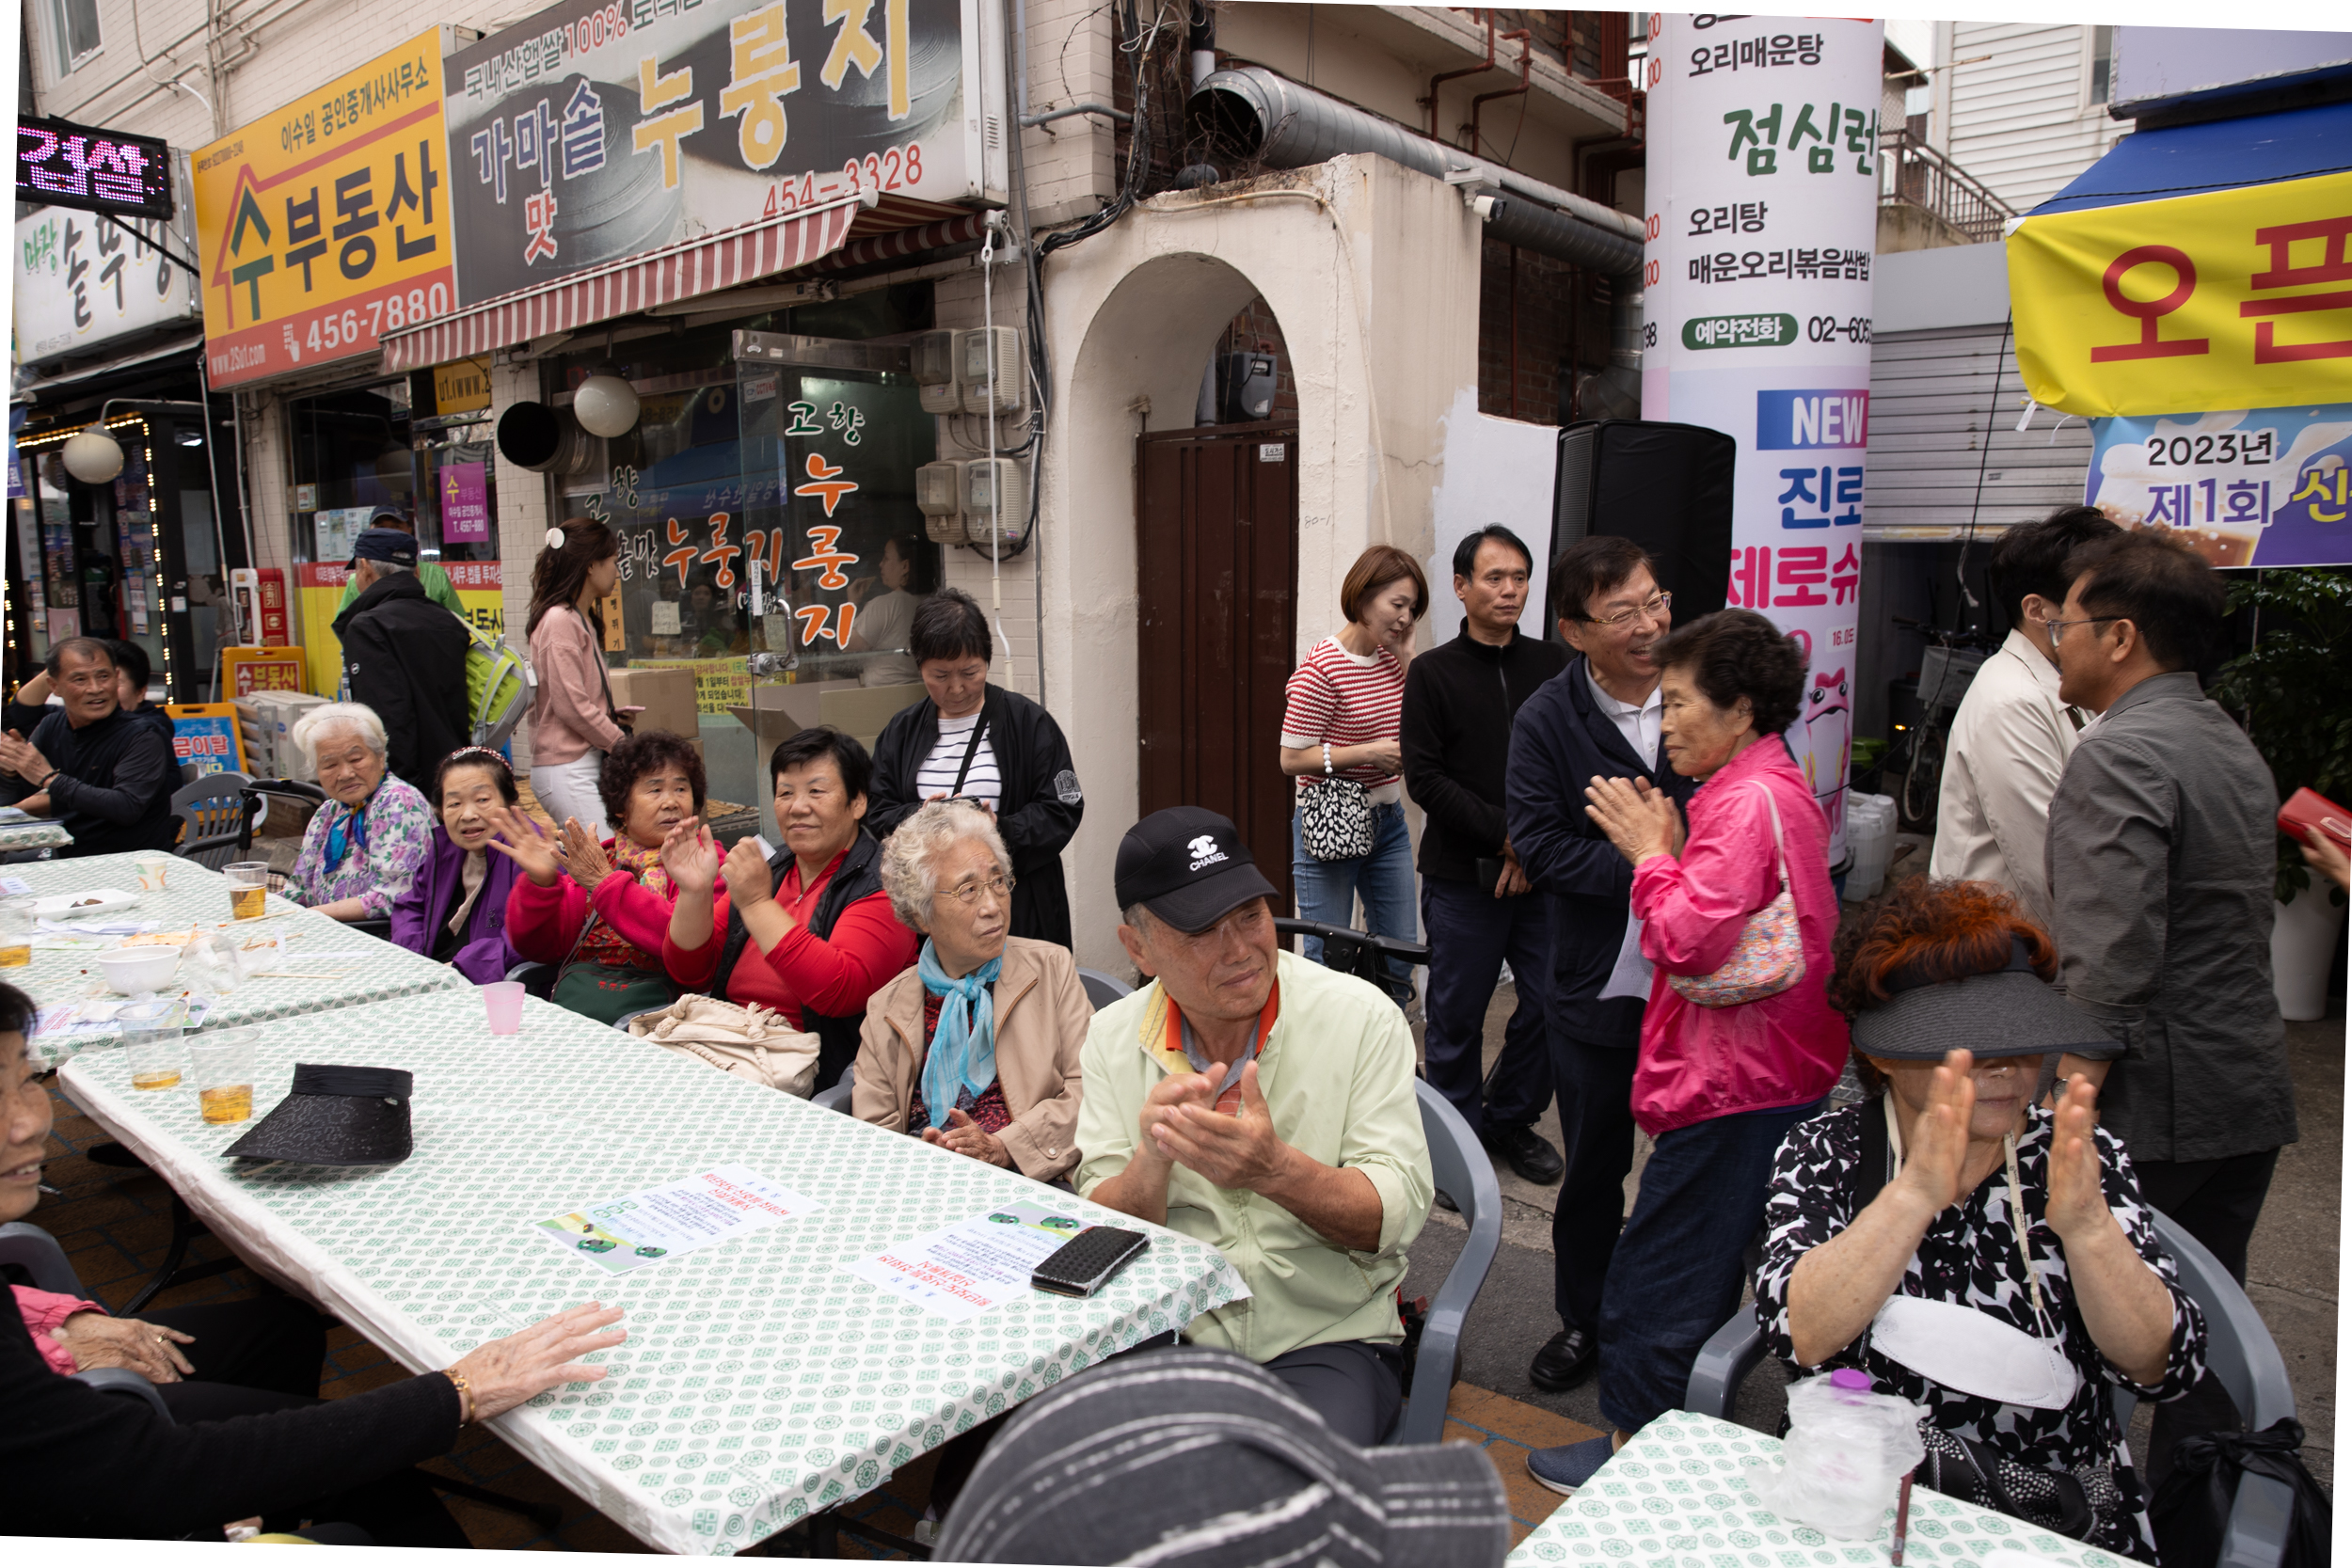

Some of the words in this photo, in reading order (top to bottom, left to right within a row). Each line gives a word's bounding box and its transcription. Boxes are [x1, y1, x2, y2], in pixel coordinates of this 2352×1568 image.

[1689, 34, 1824, 77] 오리매운탕
[281, 109, 316, 153] 이수일
[322, 55, 430, 136] 공인중개사사무소
[471, 79, 607, 203] 가마솥
[632, 0, 911, 188] 누룽지
[1724, 103, 1881, 177] 점심런
[764, 145, 923, 217] 454-3328
[524, 189, 558, 266] 맛
[1688, 201, 1768, 237] 오리탕
[1689, 248, 1870, 284] 매운오리볶음쌈밥
[307, 282, 449, 353] 456-7880
[1695, 317, 1783, 346] 예약전화
[785, 401, 865, 446] 고향
[1791, 395, 1865, 446] NEW
[2148, 432, 2273, 467] 2023년
[446, 475, 460, 504] 수
[1778, 466, 1864, 529] 진로
[2143, 478, 2270, 526] 제1회
[2293, 468, 2351, 523] 신
[663, 512, 783, 589] 누룽지
[792, 452, 859, 650] 누룽지
[264, 583, 276, 606] 소화기
[1726, 542, 1863, 609] 제로슈
[695, 662, 732, 674] 감사합니다.
[706, 675, 730, 688] 1일부터
[707, 688, 745, 701] 되었습니다.
[1189, 851, 1229, 871] CHANEL
